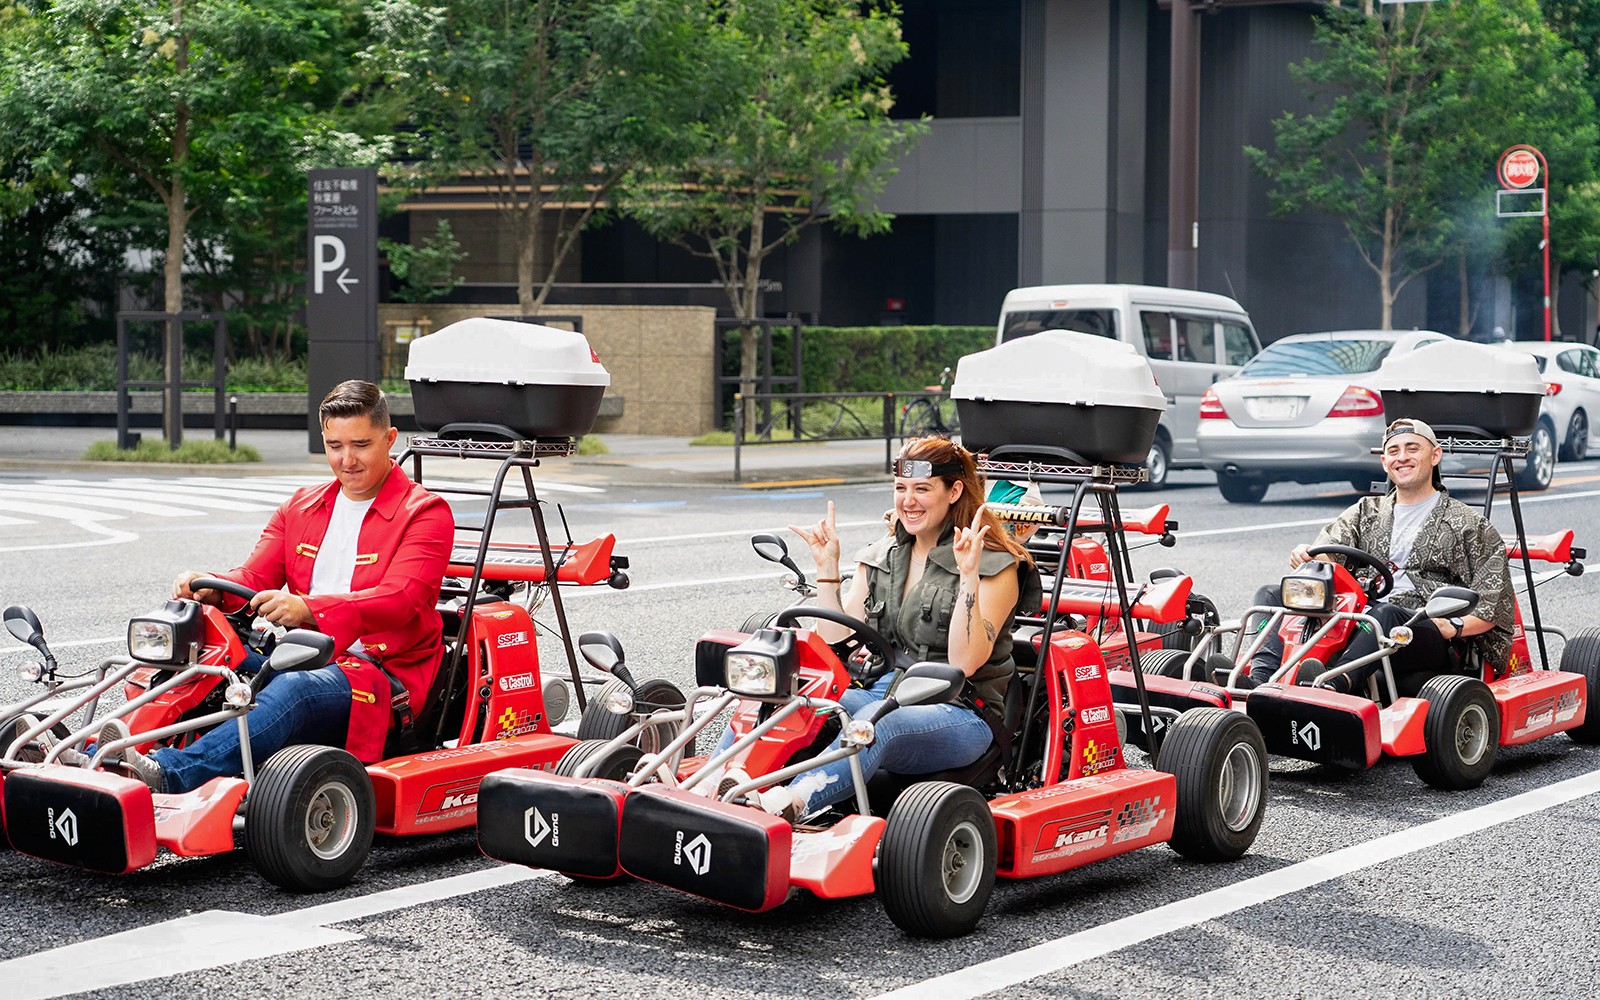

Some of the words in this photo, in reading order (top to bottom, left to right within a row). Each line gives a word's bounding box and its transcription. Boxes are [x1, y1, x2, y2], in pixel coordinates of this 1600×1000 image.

[314, 235, 346, 294] P
[994, 509, 1053, 523] ENTHAL
[507, 673, 535, 690] Castrol
[1087, 707, 1109, 723] Castrol
[1290, 720, 1299, 745] GronG
[441, 793, 479, 810] Ka
[47, 807, 56, 839] GronG
[414, 806, 478, 826] streetpo
[551, 812, 560, 847] GronG
[1054, 825, 1110, 848] Kart
[673, 830, 684, 866] GronG
